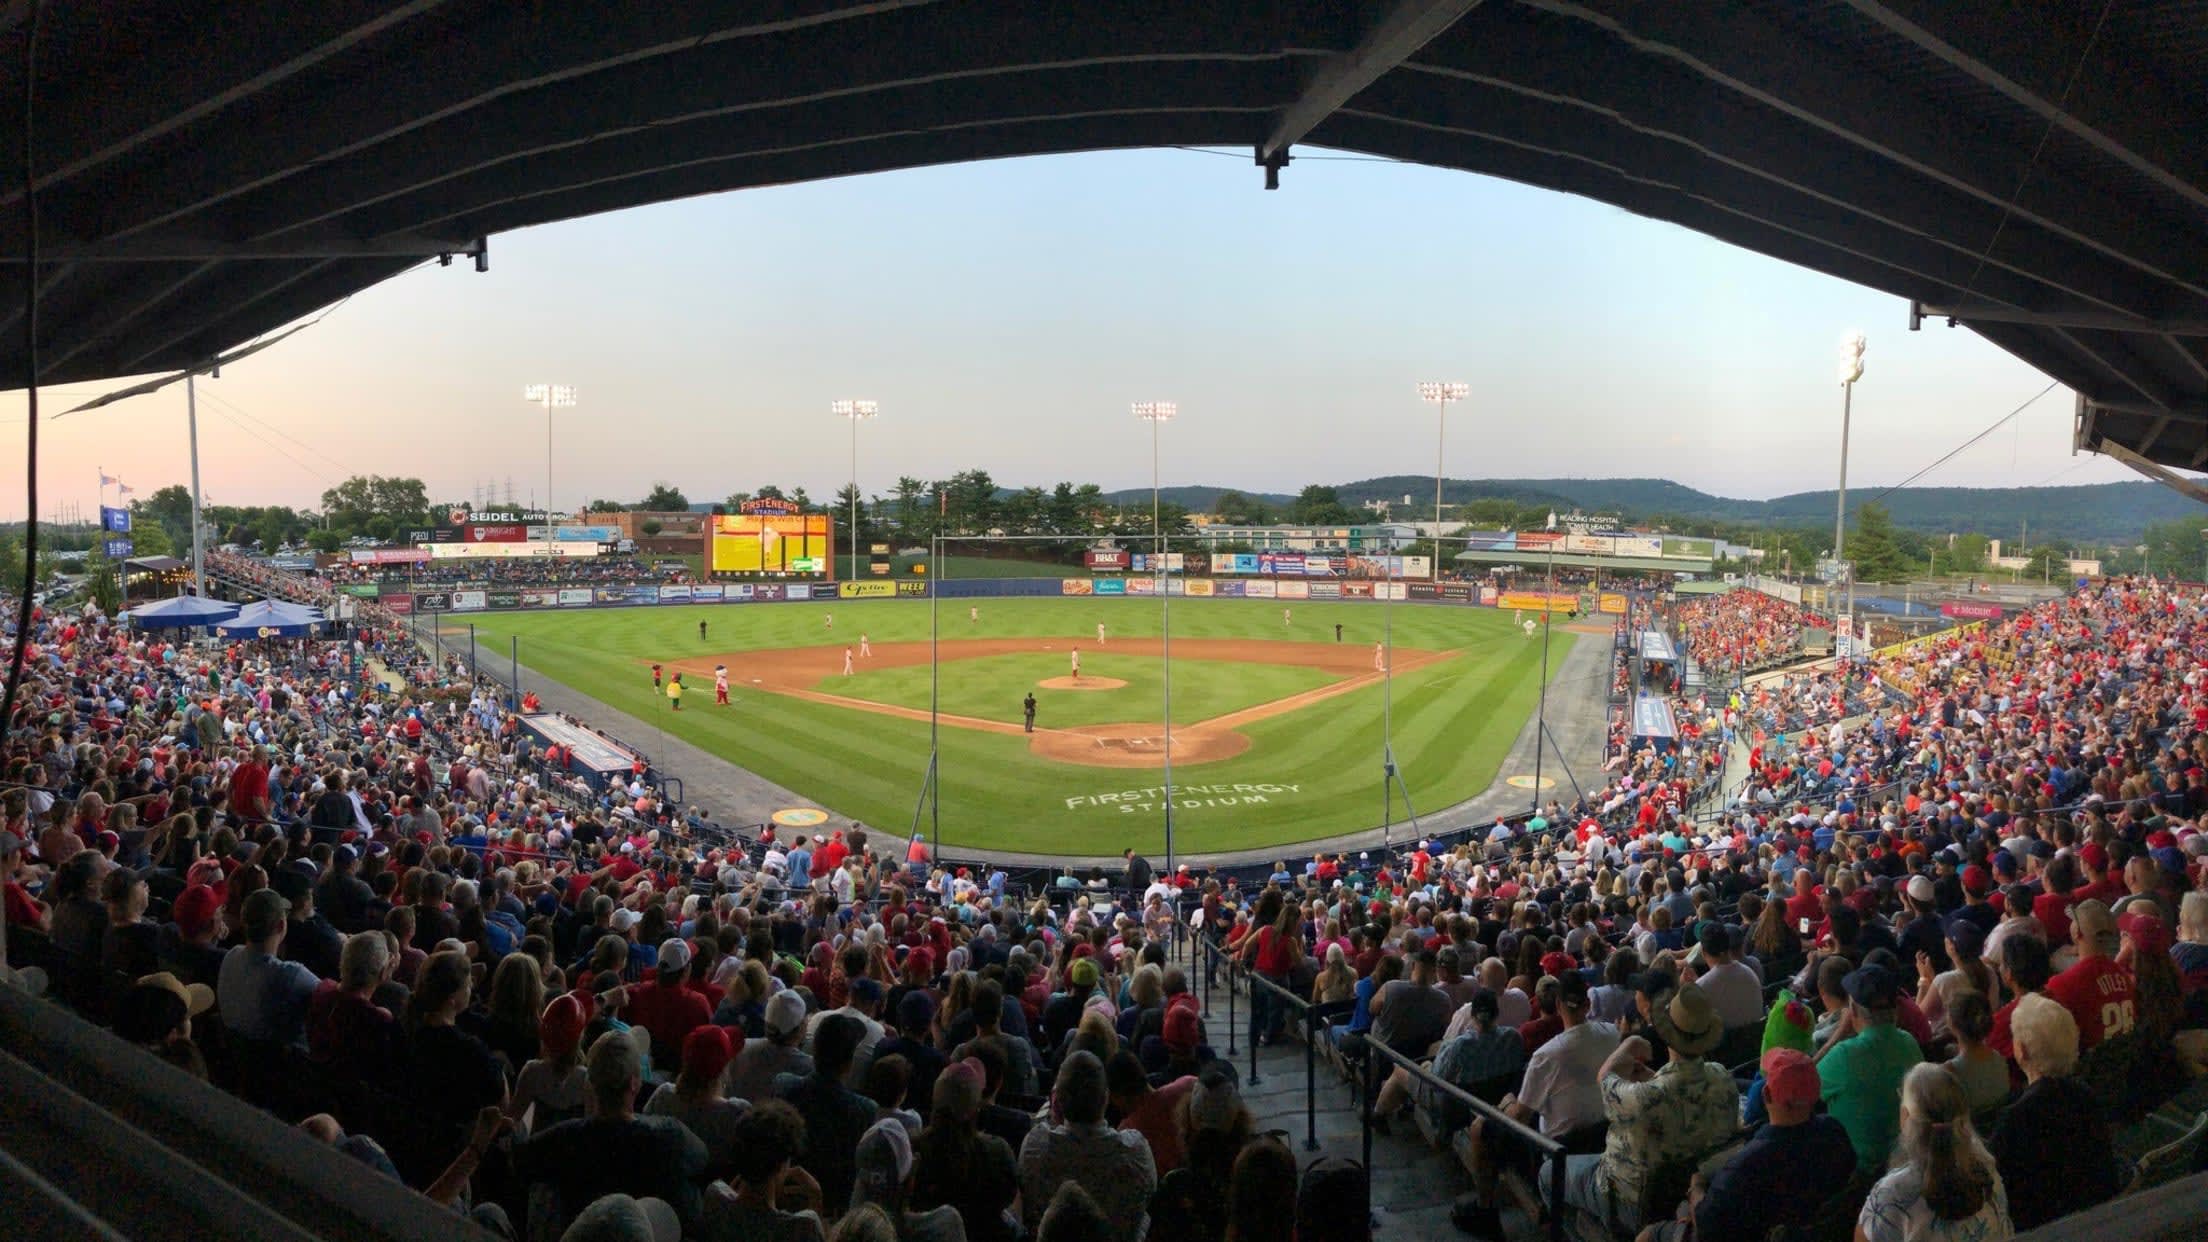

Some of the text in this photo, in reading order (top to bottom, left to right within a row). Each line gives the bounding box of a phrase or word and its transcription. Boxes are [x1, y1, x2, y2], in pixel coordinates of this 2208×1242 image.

[740, 497, 800, 513] FIRSTENERGY
[469, 512, 520, 522] SEIDEL
[522, 513, 545, 521] AUTO
[1589, 516, 1619, 524] HOSPITAL
[1591, 523, 1614, 531] HEALTH
[1065, 783, 1301, 810] FIRSTENERGY
[1119, 794, 1269, 813] STADIUM
